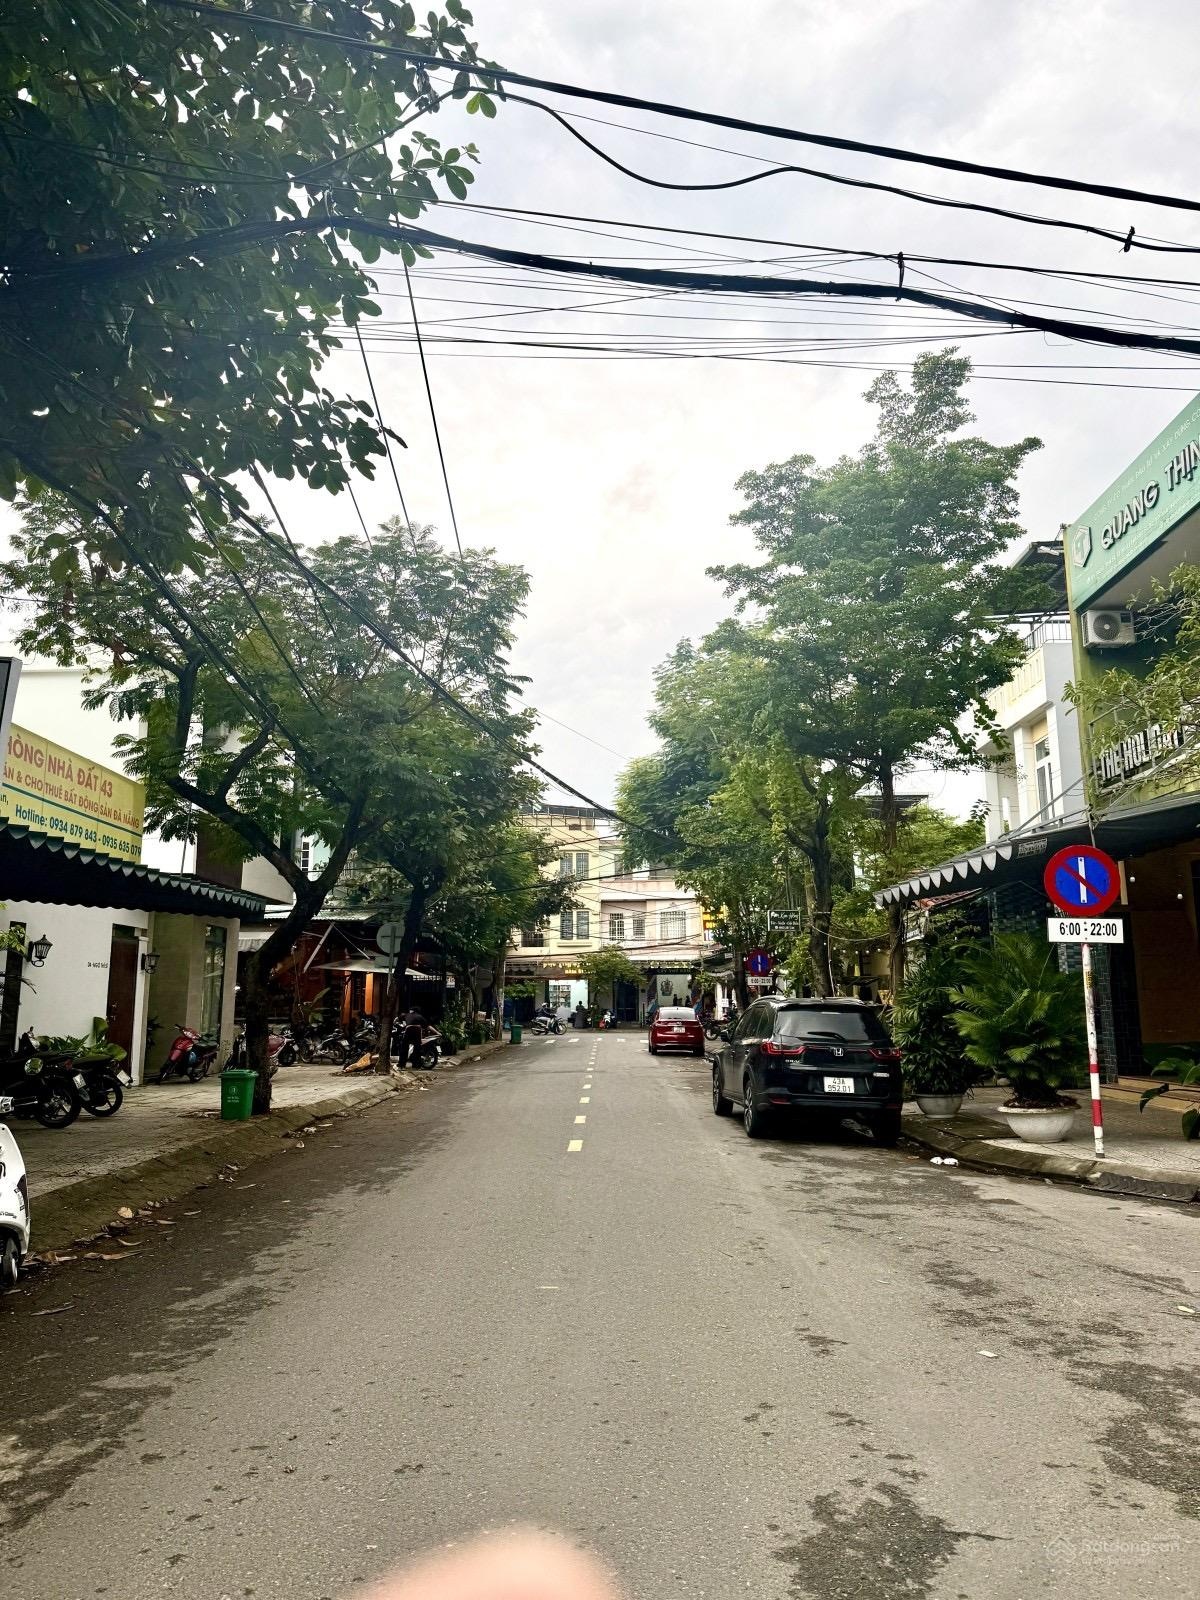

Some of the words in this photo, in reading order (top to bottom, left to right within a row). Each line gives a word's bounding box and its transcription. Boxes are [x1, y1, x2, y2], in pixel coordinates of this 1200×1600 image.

[1100, 479, 1160, 550] QUANG
[47, 754, 74, 782] NHÀ
[77, 765, 99, 793] ĐẤT
[100, 779, 113, 798] 43
[1100, 743, 1121, 781] THE
[17, 770, 23, 783] &
[24, 774, 44, 792] CHO
[44, 782, 63, 801] THUÊ
[64, 786, 77, 805] BẤT
[78, 795, 99, 813] ĐỘNG
[99, 803, 113, 819] SẢN
[114, 809, 122, 823] ĐÀ
[15, 804, 48, 827] Hotline:
[49, 817, 68, 834] 0934
[70, 823, 83, 838] 879
[102, 836, 118, 850] 0935
[118, 841, 130, 853] 635
[130, 844, 141, 857] 079
[1059, 922, 1081, 936] 6:00
[1090, 922, 1117, 936] 22:00
